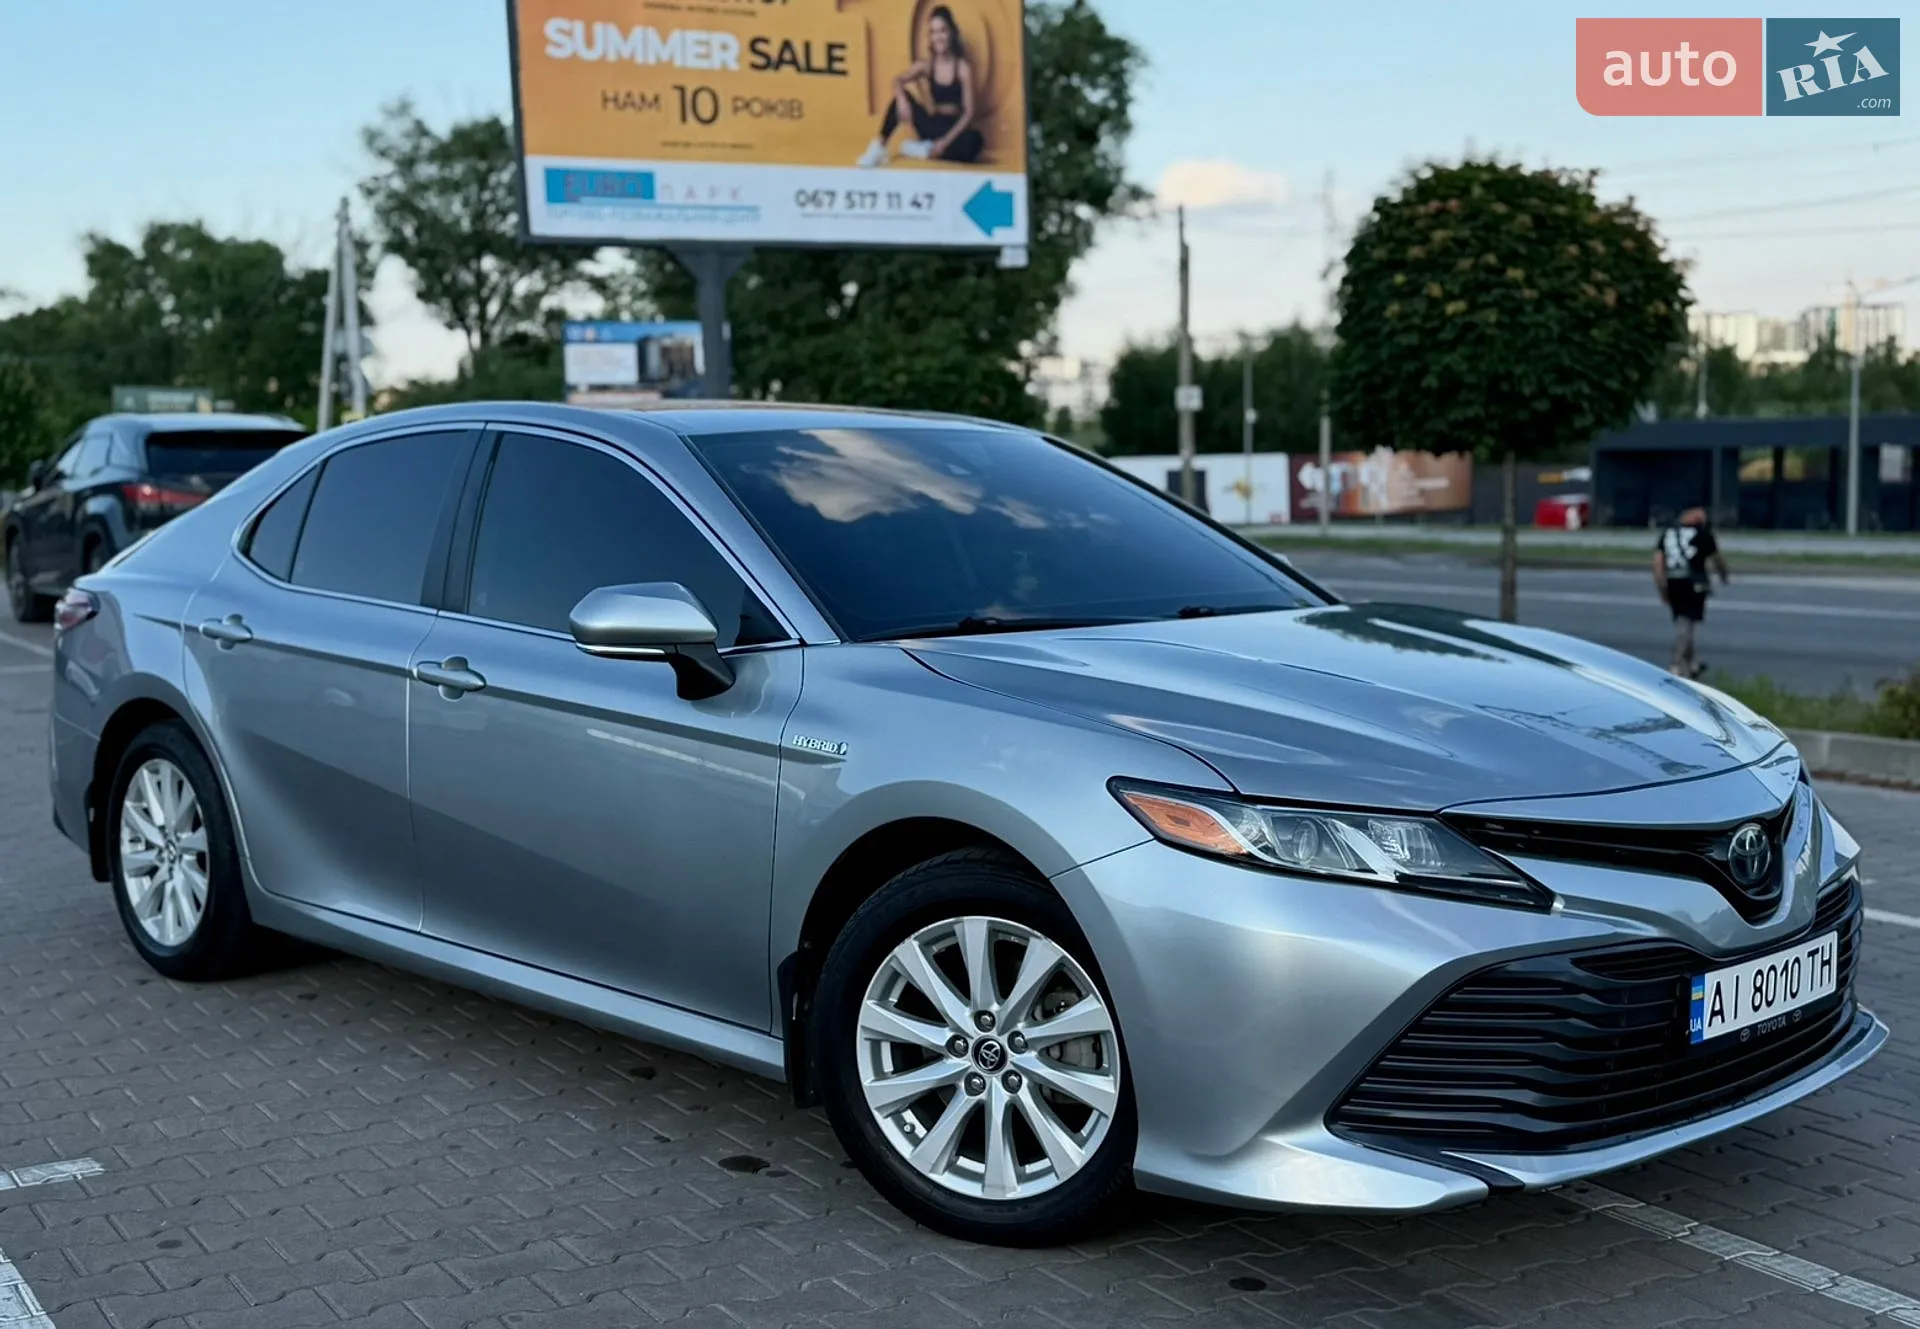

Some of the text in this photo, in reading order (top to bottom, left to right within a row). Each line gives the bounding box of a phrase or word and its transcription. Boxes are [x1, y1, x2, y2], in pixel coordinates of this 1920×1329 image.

[543, 17, 849, 76] SUMMER SALE
[601, 84, 805, 125] НАМ 10 РОКІВ
[795, 188, 935, 211] 067 517 11 47
[792, 734, 838, 754] HYBRID
[1707, 942, 1833, 1028] AI 8010 TH
[1689, 1017, 1702, 1032] UA
[1757, 1015, 1787, 1036] TOYOTA
